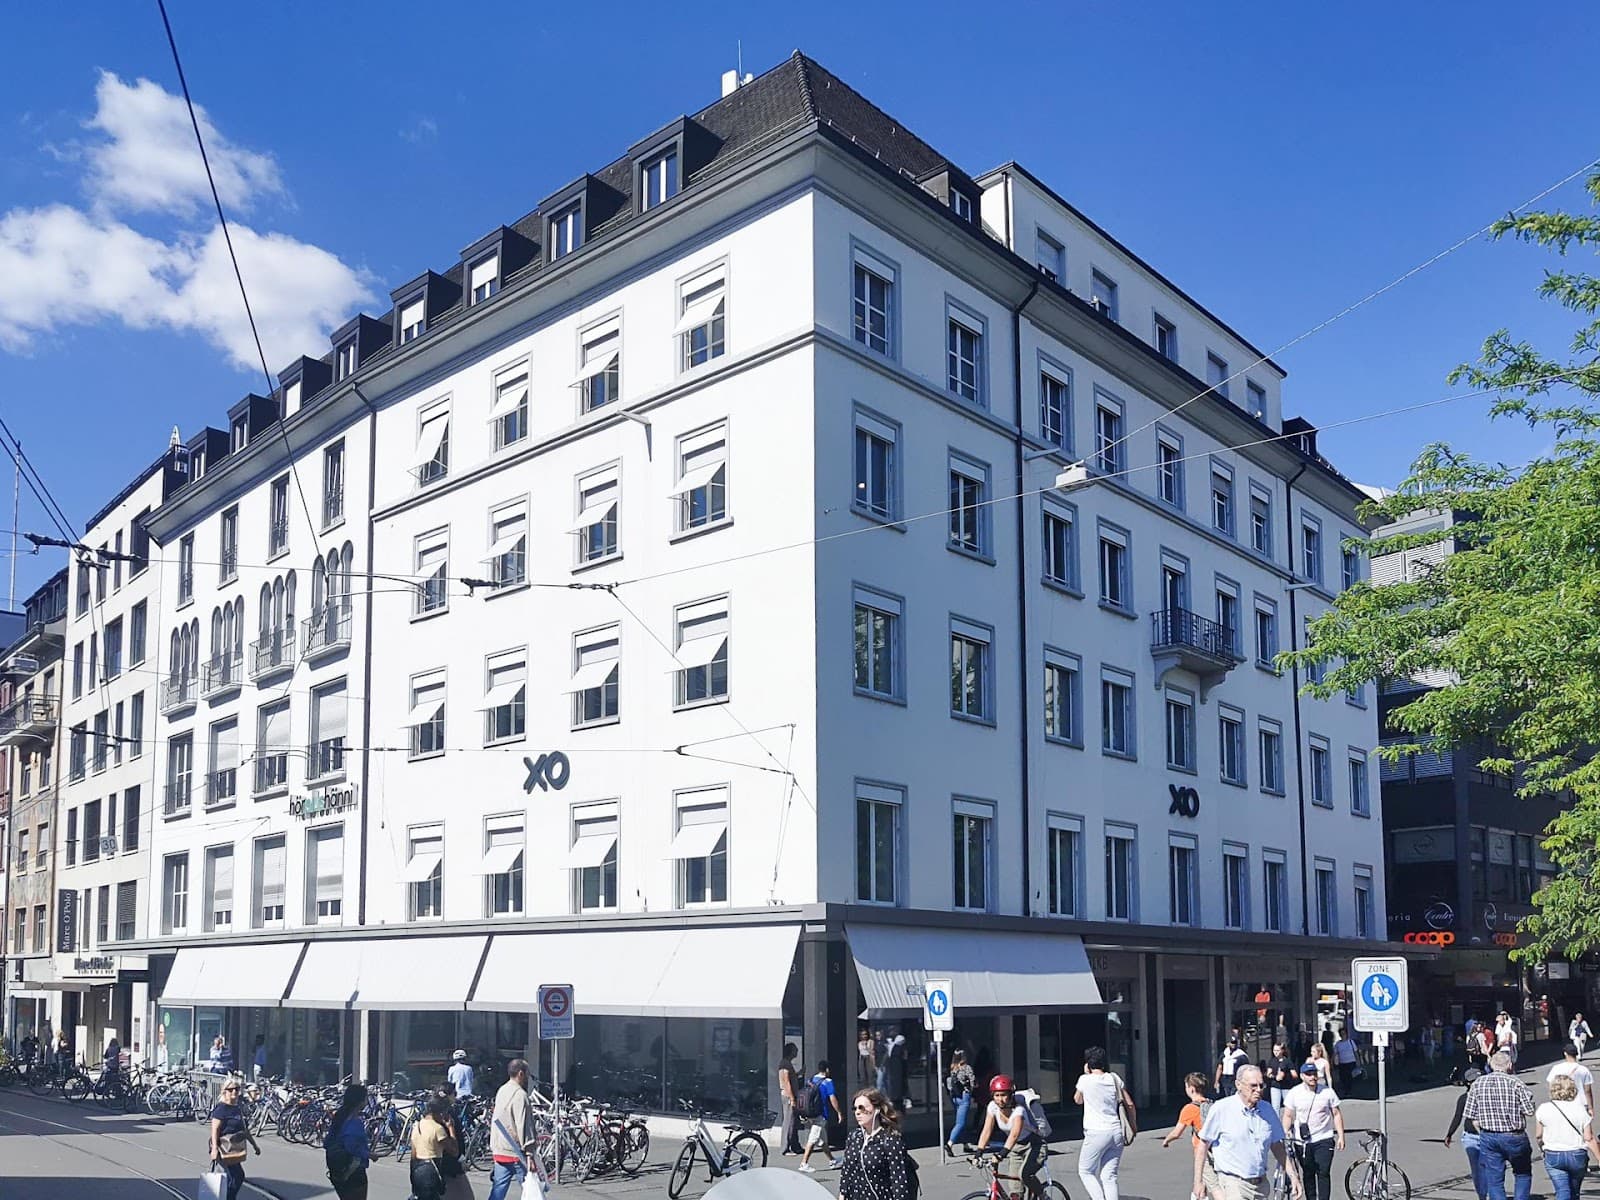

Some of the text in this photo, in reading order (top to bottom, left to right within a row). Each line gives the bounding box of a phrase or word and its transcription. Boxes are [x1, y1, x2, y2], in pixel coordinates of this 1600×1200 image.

[523, 750, 571, 794] XO
[1168, 783, 1200, 818] XO
[63, 926, 71, 950] Marc
[1404, 932, 1455, 947] coop
[1368, 964, 1391, 973] ZONE
